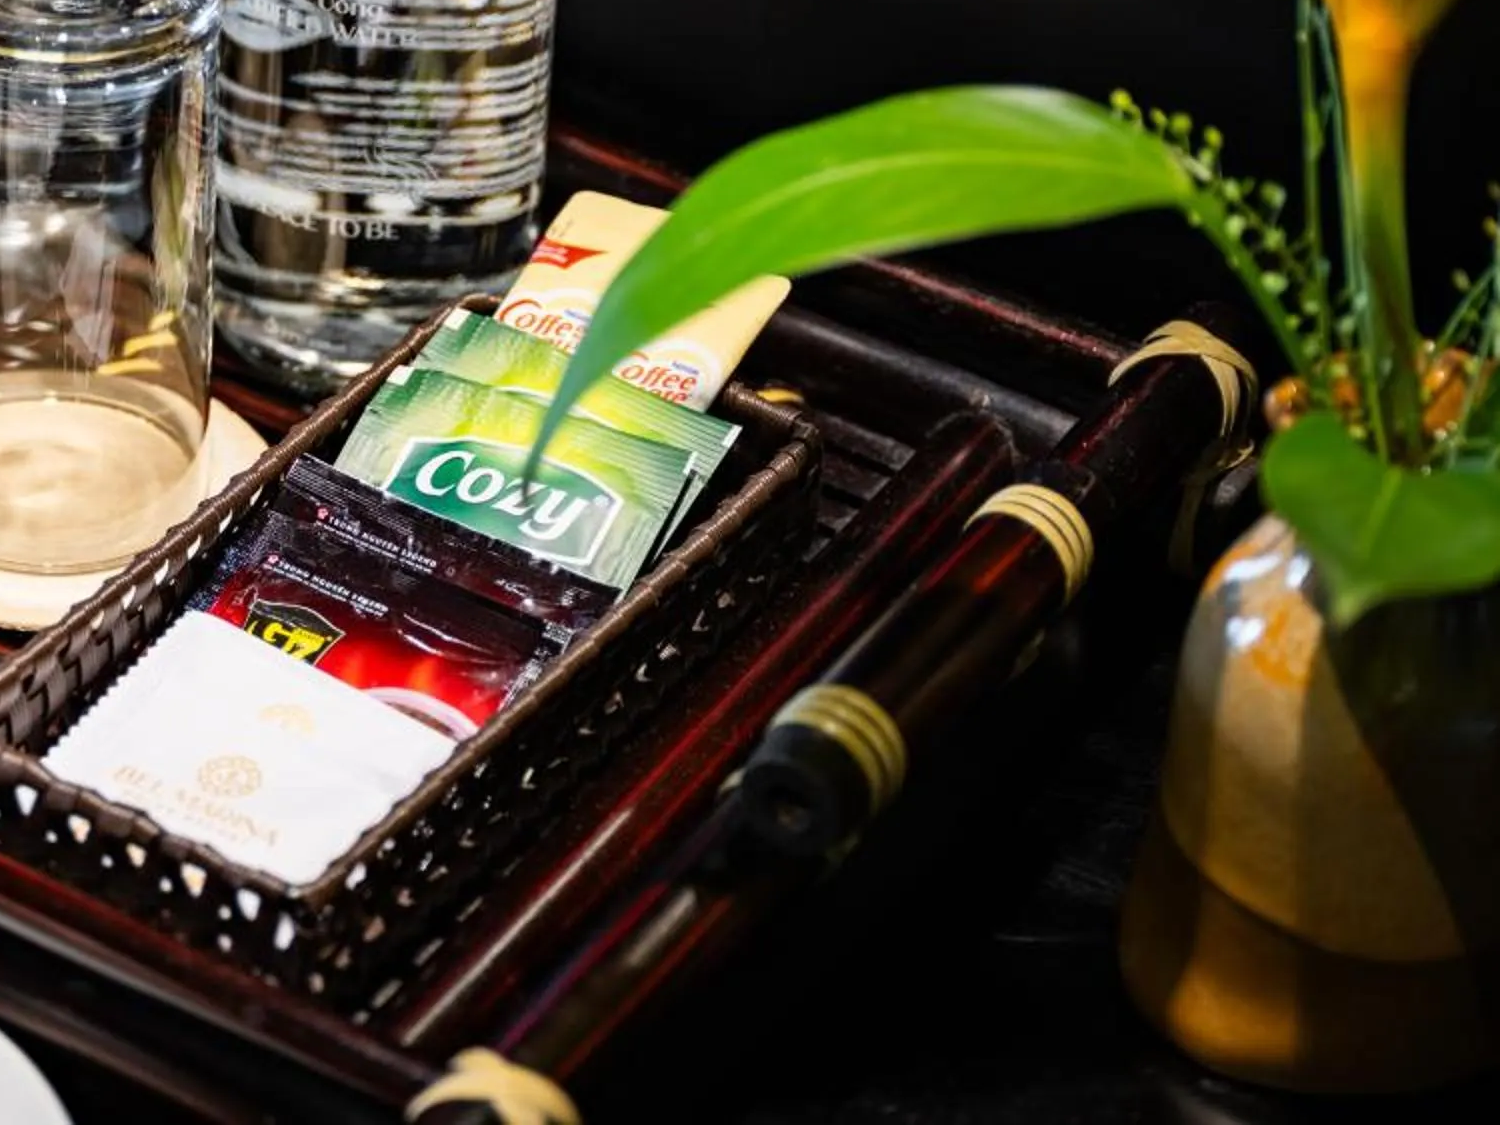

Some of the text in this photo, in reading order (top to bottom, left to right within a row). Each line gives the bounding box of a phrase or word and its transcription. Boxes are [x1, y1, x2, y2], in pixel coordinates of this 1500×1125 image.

[365, 220, 400, 241] BE
[620, 350, 697, 392] offee
[414, 450, 589, 541] Cozy
